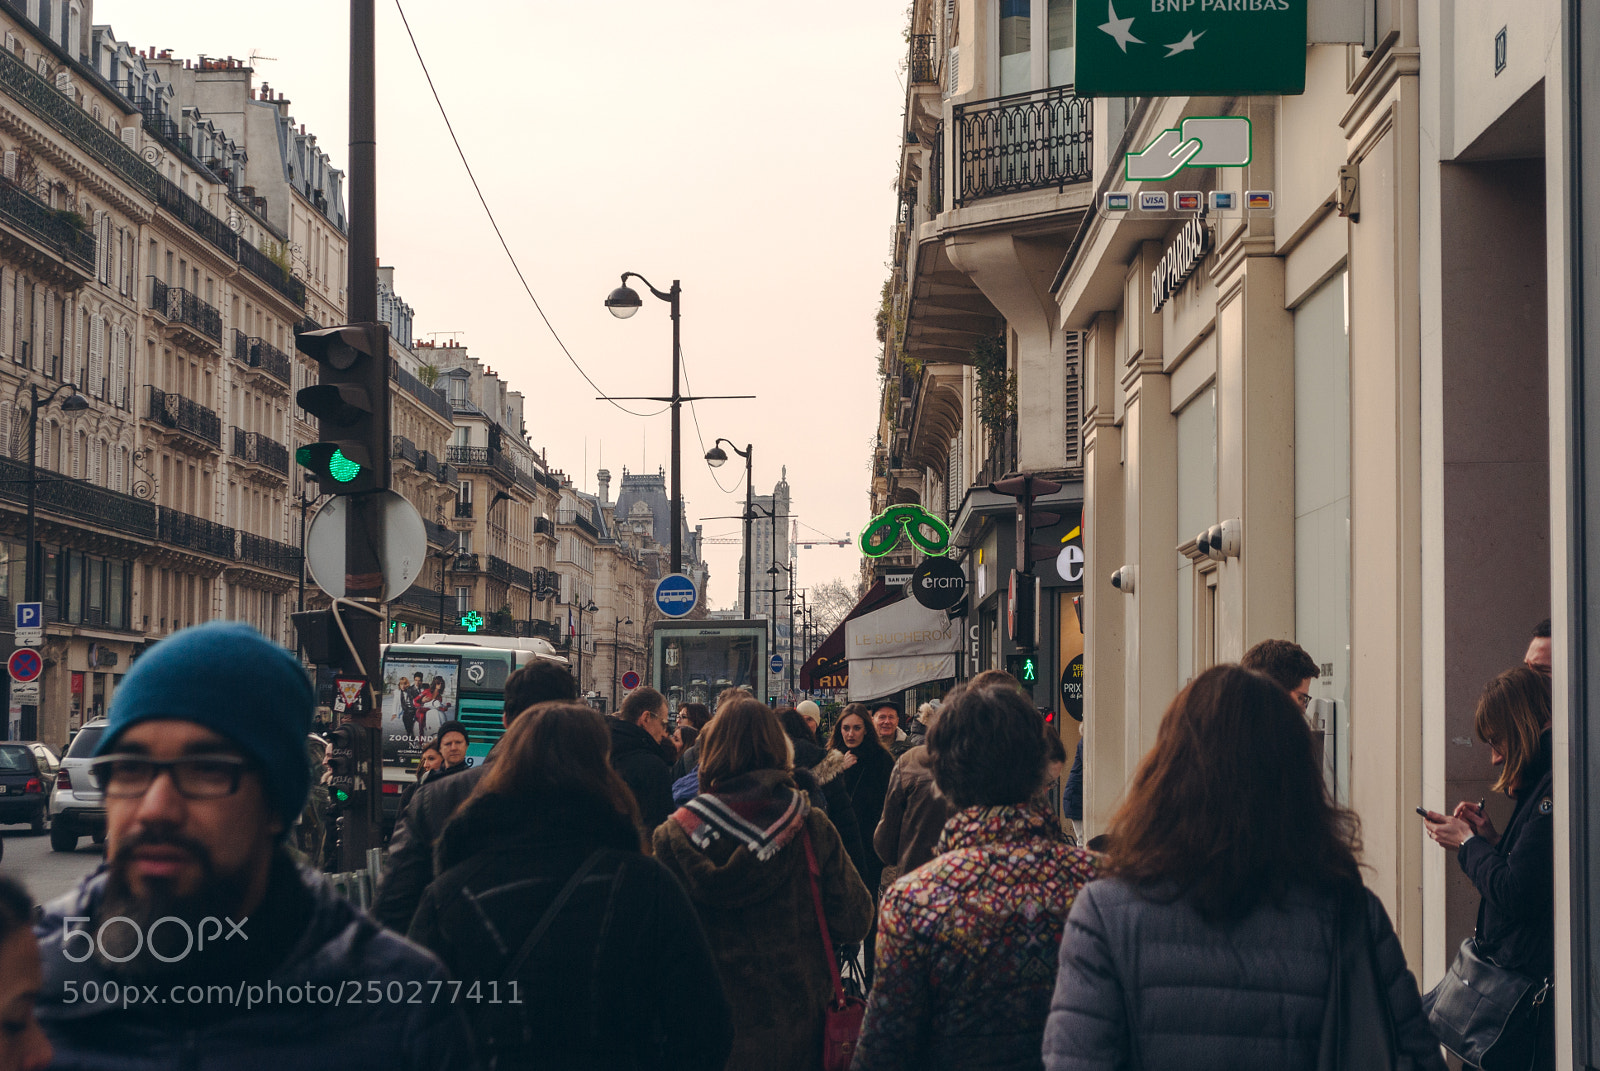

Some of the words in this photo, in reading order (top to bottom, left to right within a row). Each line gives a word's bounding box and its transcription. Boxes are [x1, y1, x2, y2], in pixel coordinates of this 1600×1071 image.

[1151, 0, 1194, 12] BNP
[1201, 0, 1289, 11] PARIBAS
[1145, 196, 1164, 204] VISA
[1152, 255, 1166, 314] BNP
[1167, 209, 1203, 292] PARIBAS
[921, 571, 963, 589] éram
[23, 608, 34, 624] P
[855, 634, 871, 646] LE
[875, 629, 952, 645] BUCHERON
[1064, 683, 1081, 692] PRIX
[389, 734, 437, 742] ZOOLAND
